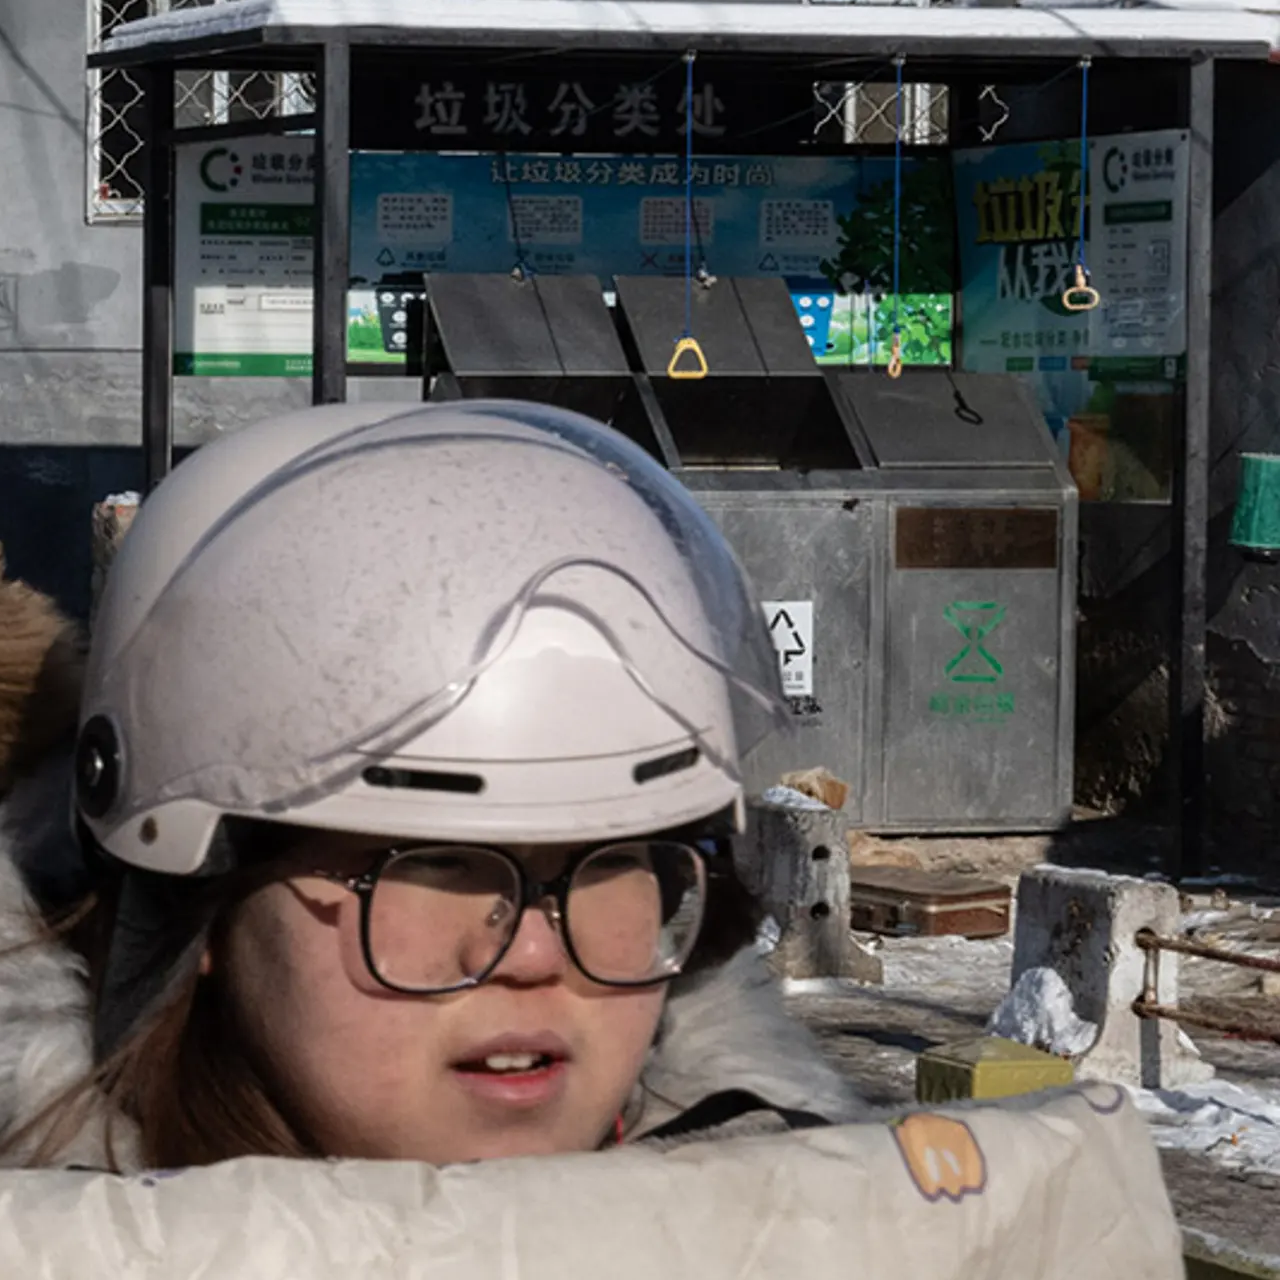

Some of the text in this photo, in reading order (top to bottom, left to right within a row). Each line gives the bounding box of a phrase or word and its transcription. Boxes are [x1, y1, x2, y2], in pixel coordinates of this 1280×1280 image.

[414, 82, 726, 137] 垃圾分类处
[491, 160, 775, 186] 让垃圾分类成为时尚
